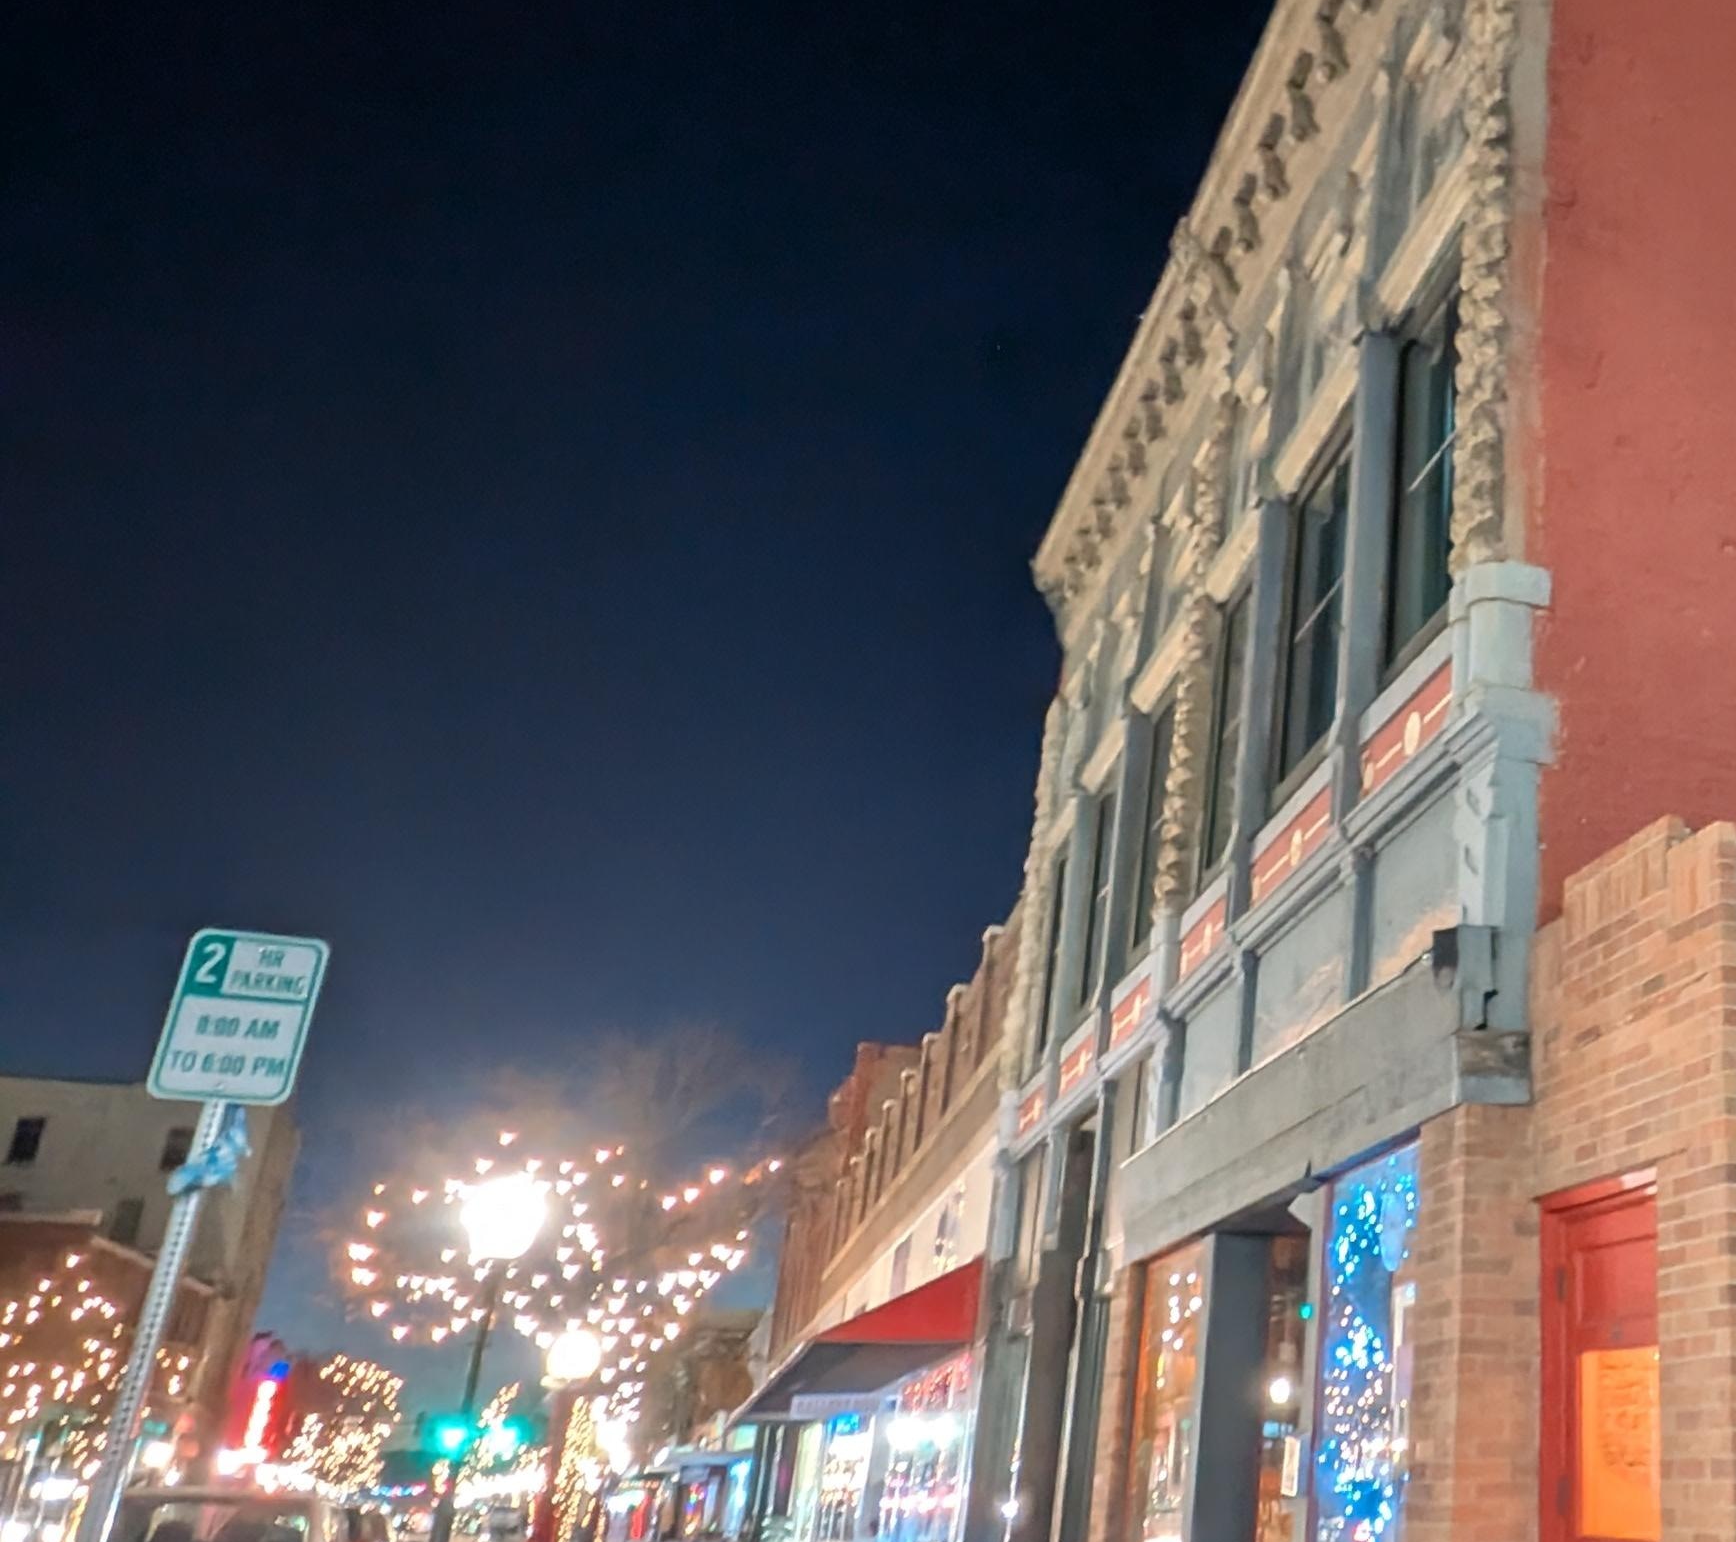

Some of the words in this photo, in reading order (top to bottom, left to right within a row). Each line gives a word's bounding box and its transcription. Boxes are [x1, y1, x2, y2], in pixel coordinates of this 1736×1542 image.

[195, 942, 227, 984] 2
[258, 948, 286, 968] HR
[230, 972, 308, 996] PARKING
[243, 1018, 281, 1040] AM
[170, 1050, 197, 1073] TO
[200, 1053, 246, 1077] 6:00
[251, 1056, 288, 1078] PM
